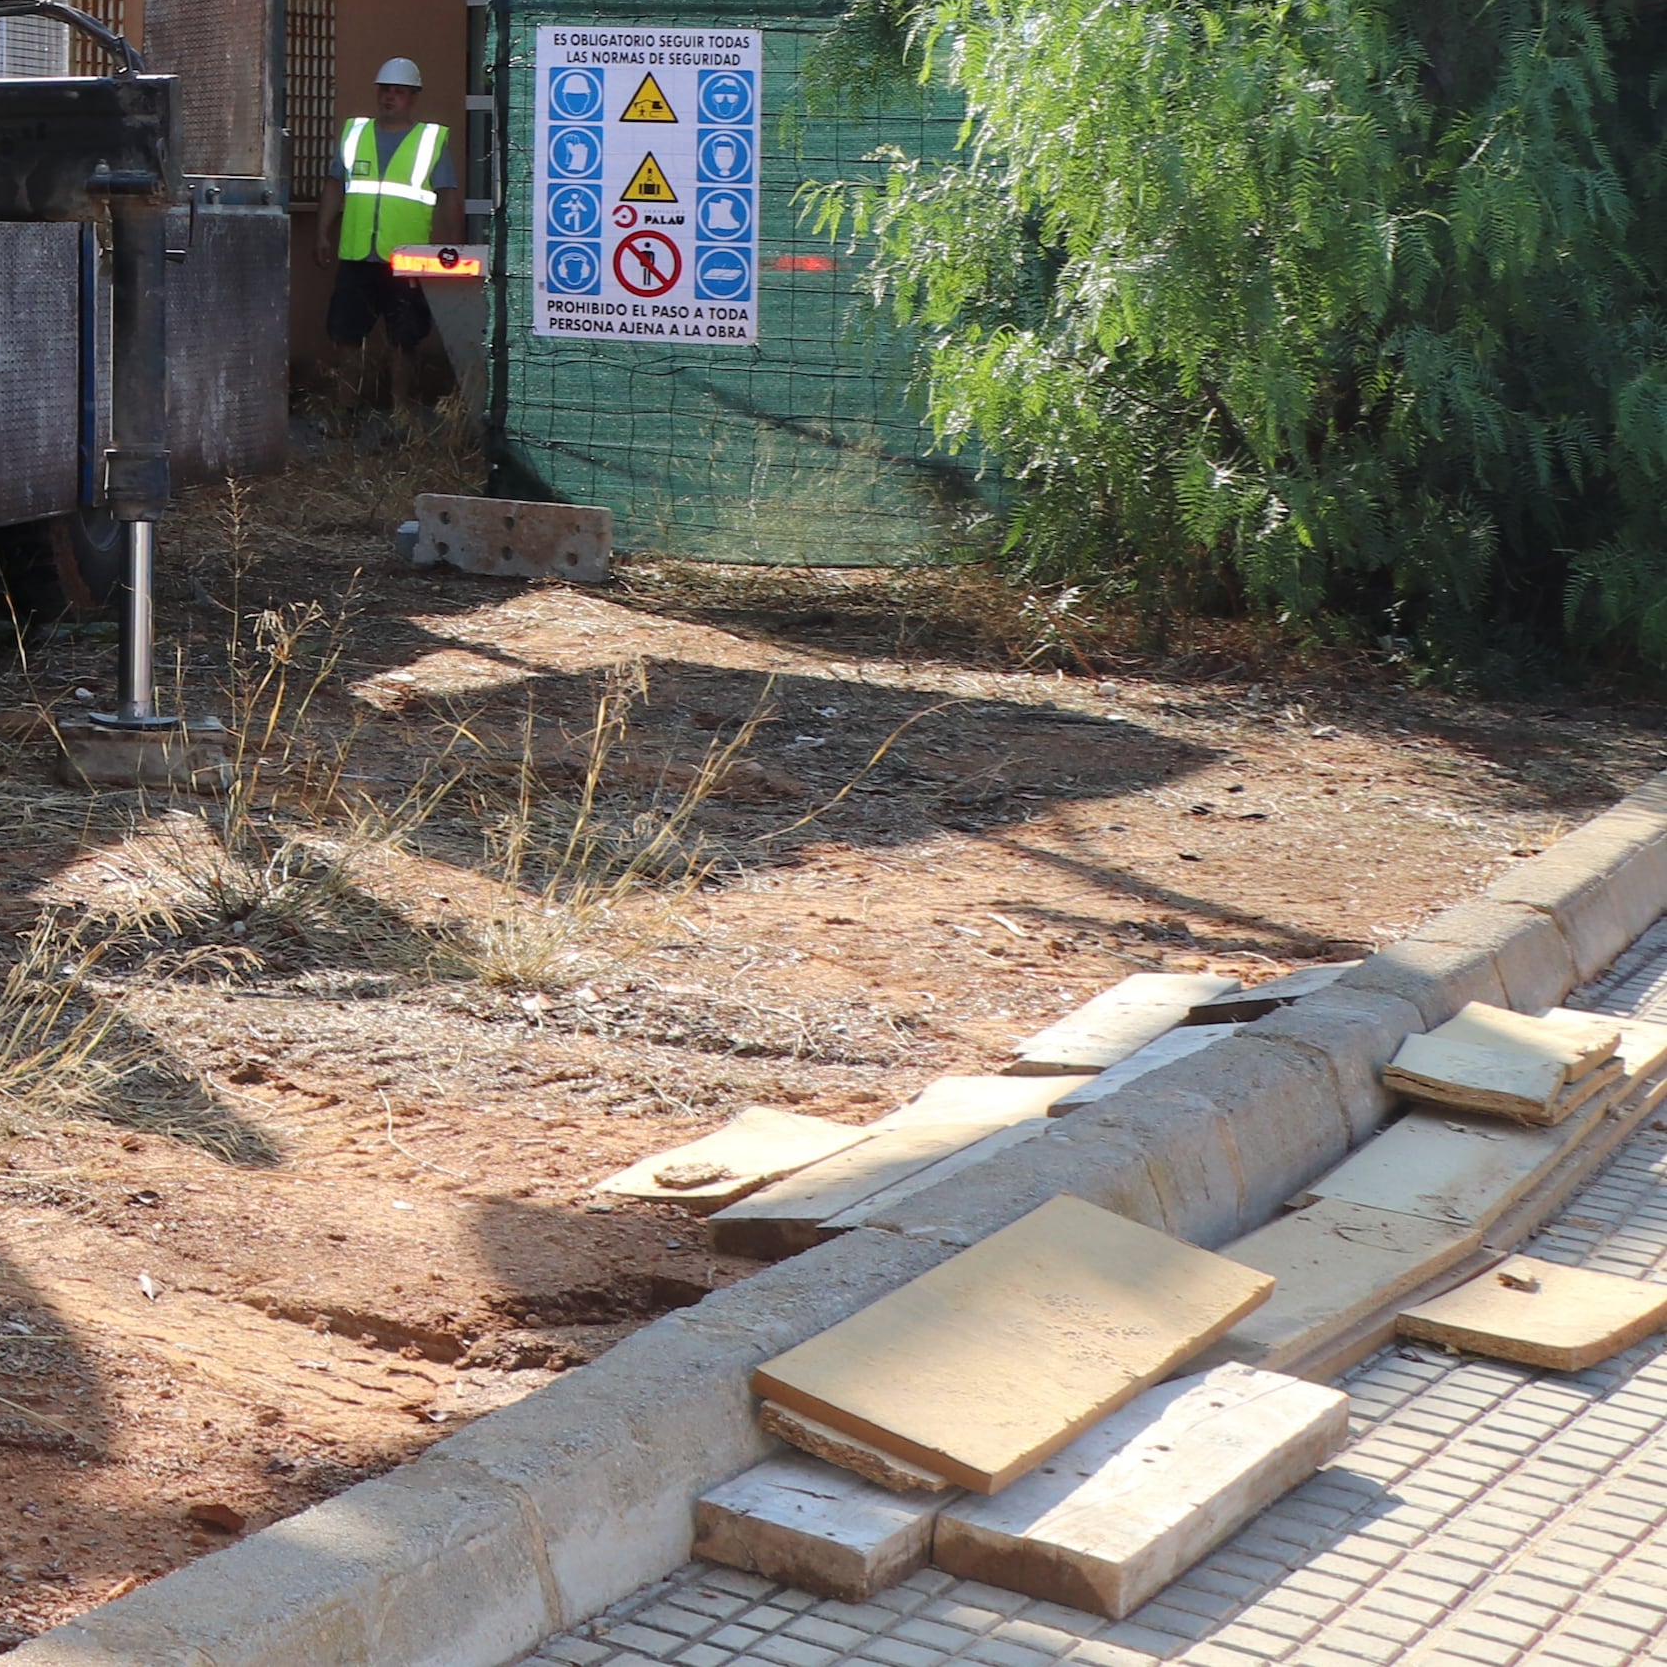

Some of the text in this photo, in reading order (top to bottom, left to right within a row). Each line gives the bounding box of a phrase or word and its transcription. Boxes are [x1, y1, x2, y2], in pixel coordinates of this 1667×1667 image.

[554, 33, 750, 49] ES OBLIGATORIO SEGUIR TODAS
[566, 50, 741, 66] LAS NORMAS DE SEGURIDAD
[644, 215, 685, 226] PALAU
[547, 299, 749, 321] PROHIBIDO EL PASO A TODA
[549, 317, 747, 339] PERSONA AJENA A LA OBRA
